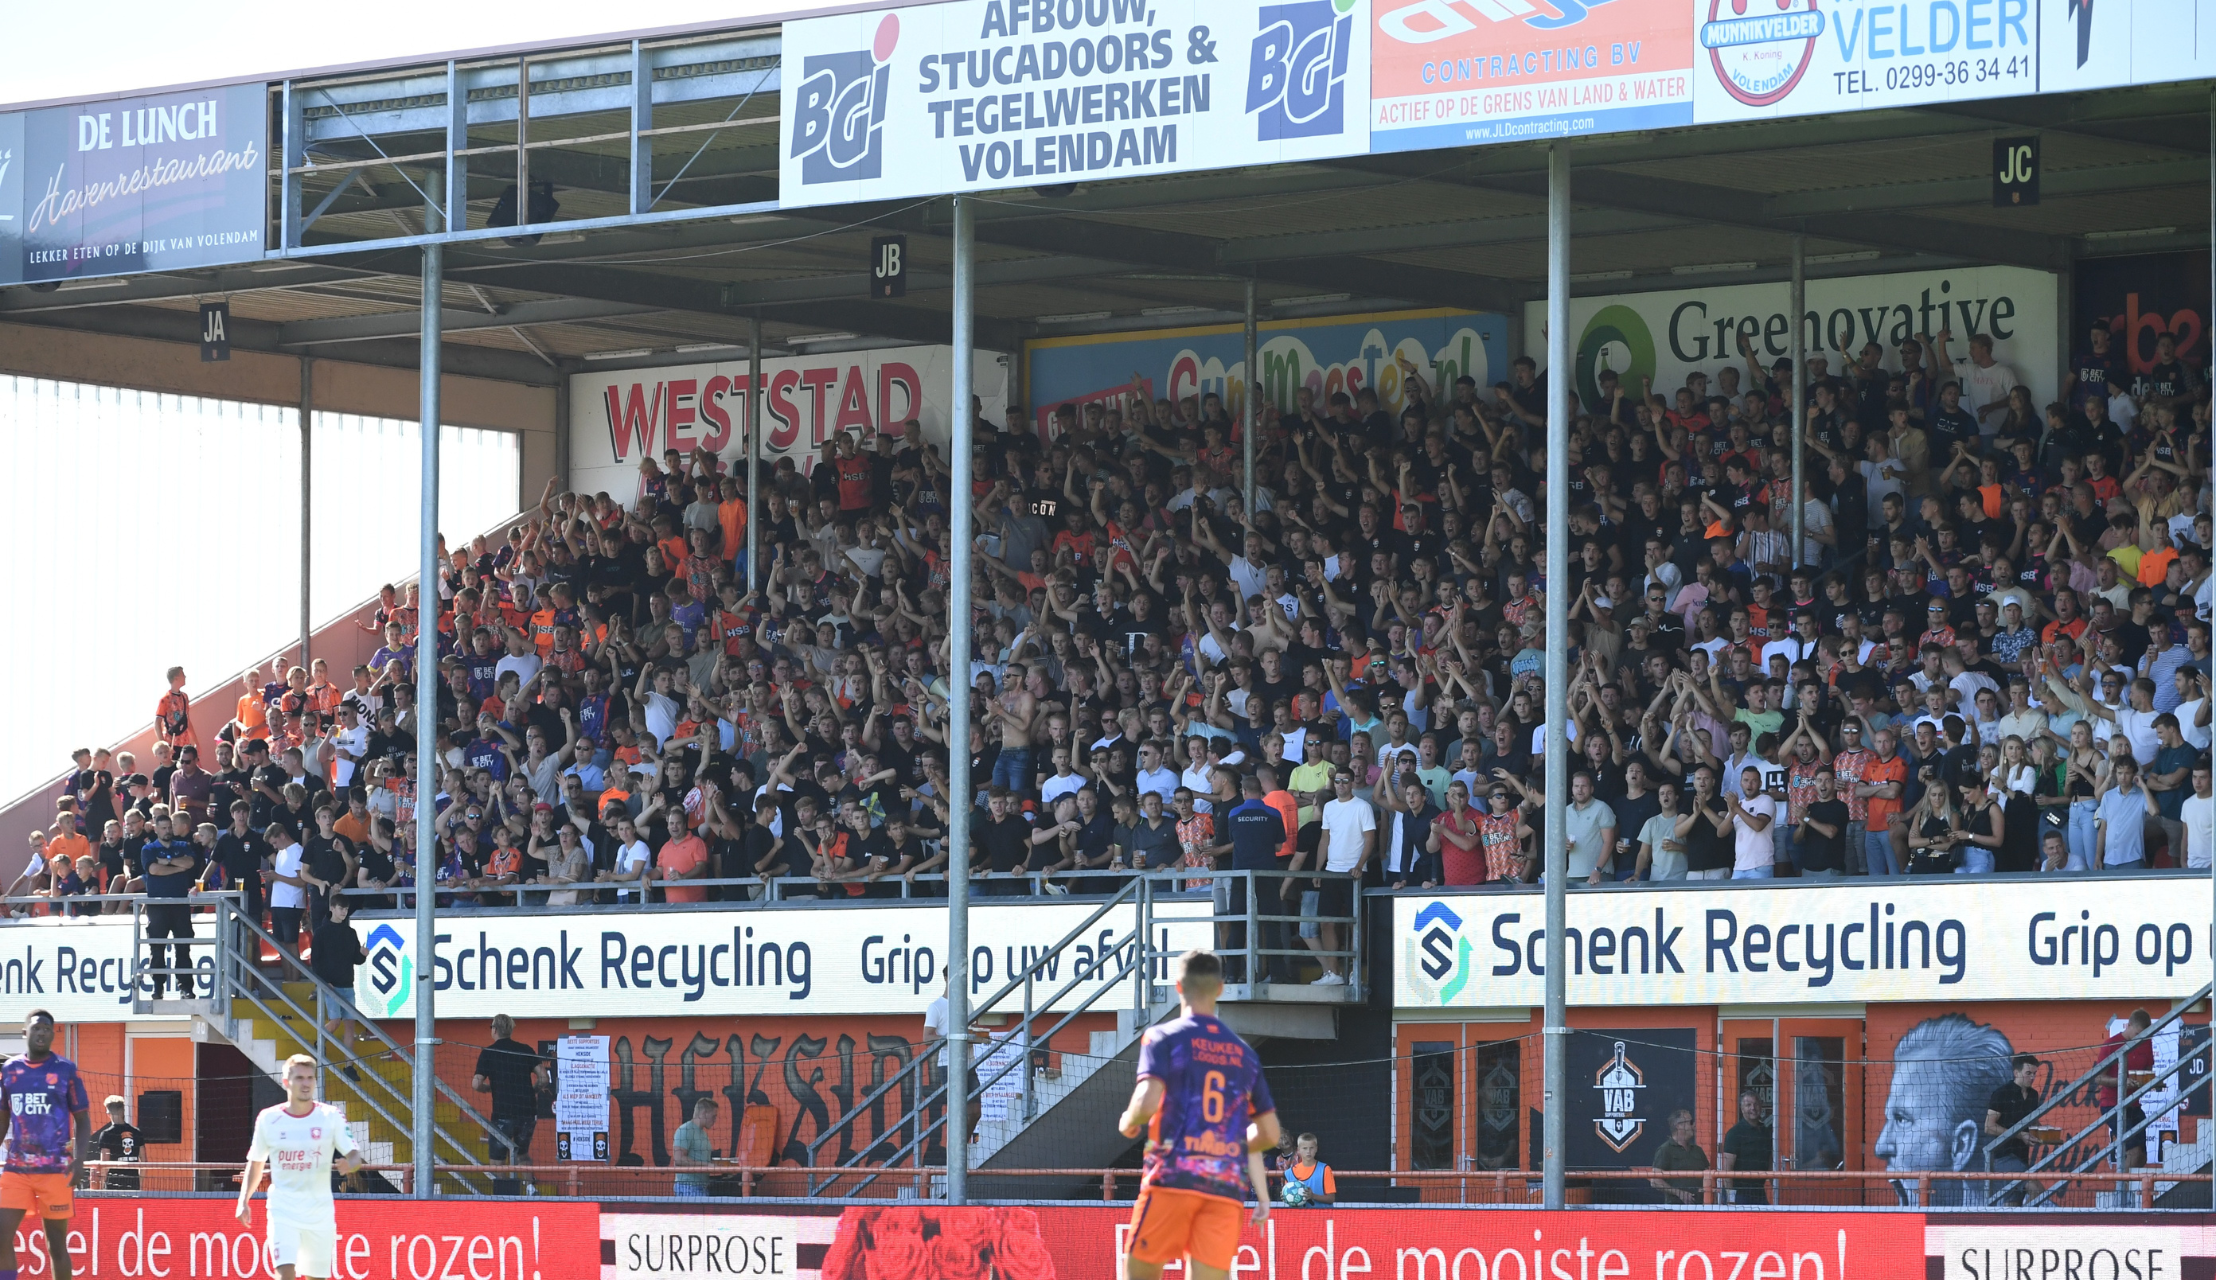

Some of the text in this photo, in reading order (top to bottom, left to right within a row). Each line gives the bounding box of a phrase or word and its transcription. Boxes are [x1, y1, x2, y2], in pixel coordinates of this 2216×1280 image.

[980, 0, 1156, 39] AFBOUW,
[1707, 14, 1818, 45] MUNNIKVELDER
[1832, 0, 2029, 63] VELDER
[918, 25, 1219, 94] STUCADOORS &
[1421, 41, 1642, 85] CONTRACTING BV
[1742, 50, 1783, 61] K. Koning
[1833, 55, 2029, 95] TEL. 0299-36 34 41
[1732, 63, 1794, 92] VOLENDAM
[927, 74, 1210, 139] TEGELWERKEN
[1379, 76, 1685, 125] ACTIEF OP DE GRENS VAN LAND & WATER
[78, 100, 217, 151] DE LUNCH
[1465, 116, 1594, 141] www.JLDcontracting.com
[958, 124, 1177, 182] VOLENDAM
[2000, 145, 2034, 184] JC
[29, 141, 259, 233] Havenrestaurant
[30, 230, 258, 264] LEKKER ETEN OP DE DIJK VAN VOLENDAM
[876, 243, 900, 278] JB
[203, 310, 225, 343] JA
[604, 361, 922, 464] WESTSTAD
[1238, 815, 1268, 823] SECURITY
[435, 929, 586, 990] Schenk
[602, 926, 811, 1001] Recycling
[861, 934, 934, 994] Grip
[972, 945, 993, 994] p
[1007, 946, 1058, 981] uw
[1074, 929, 1168, 981] afvl
[1706, 902, 1966, 987] Recycling
[2029, 910, 2119, 978] Grip
[2136, 923, 2192, 977] op
[57, 944, 215, 1004] Recycig
[1191, 1038, 1243, 1057] KEUKEN
[2189, 1059, 2204, 1074] JD
[25, 1093, 47, 1103] BET
[25, 1104, 51, 1114] CITY
[1203, 1070, 1225, 1123] 6
[1603, 1089, 1634, 1112] VAB
[279, 1150, 305, 1162] pure
[282, 1161, 312, 1171] energie
[118, 1208, 171, 1277] de
[391, 1216, 541, 1280] rozen!
[628, 1233, 783, 1275] SURPROSE
[1302, 1219, 1371, 1280] de
